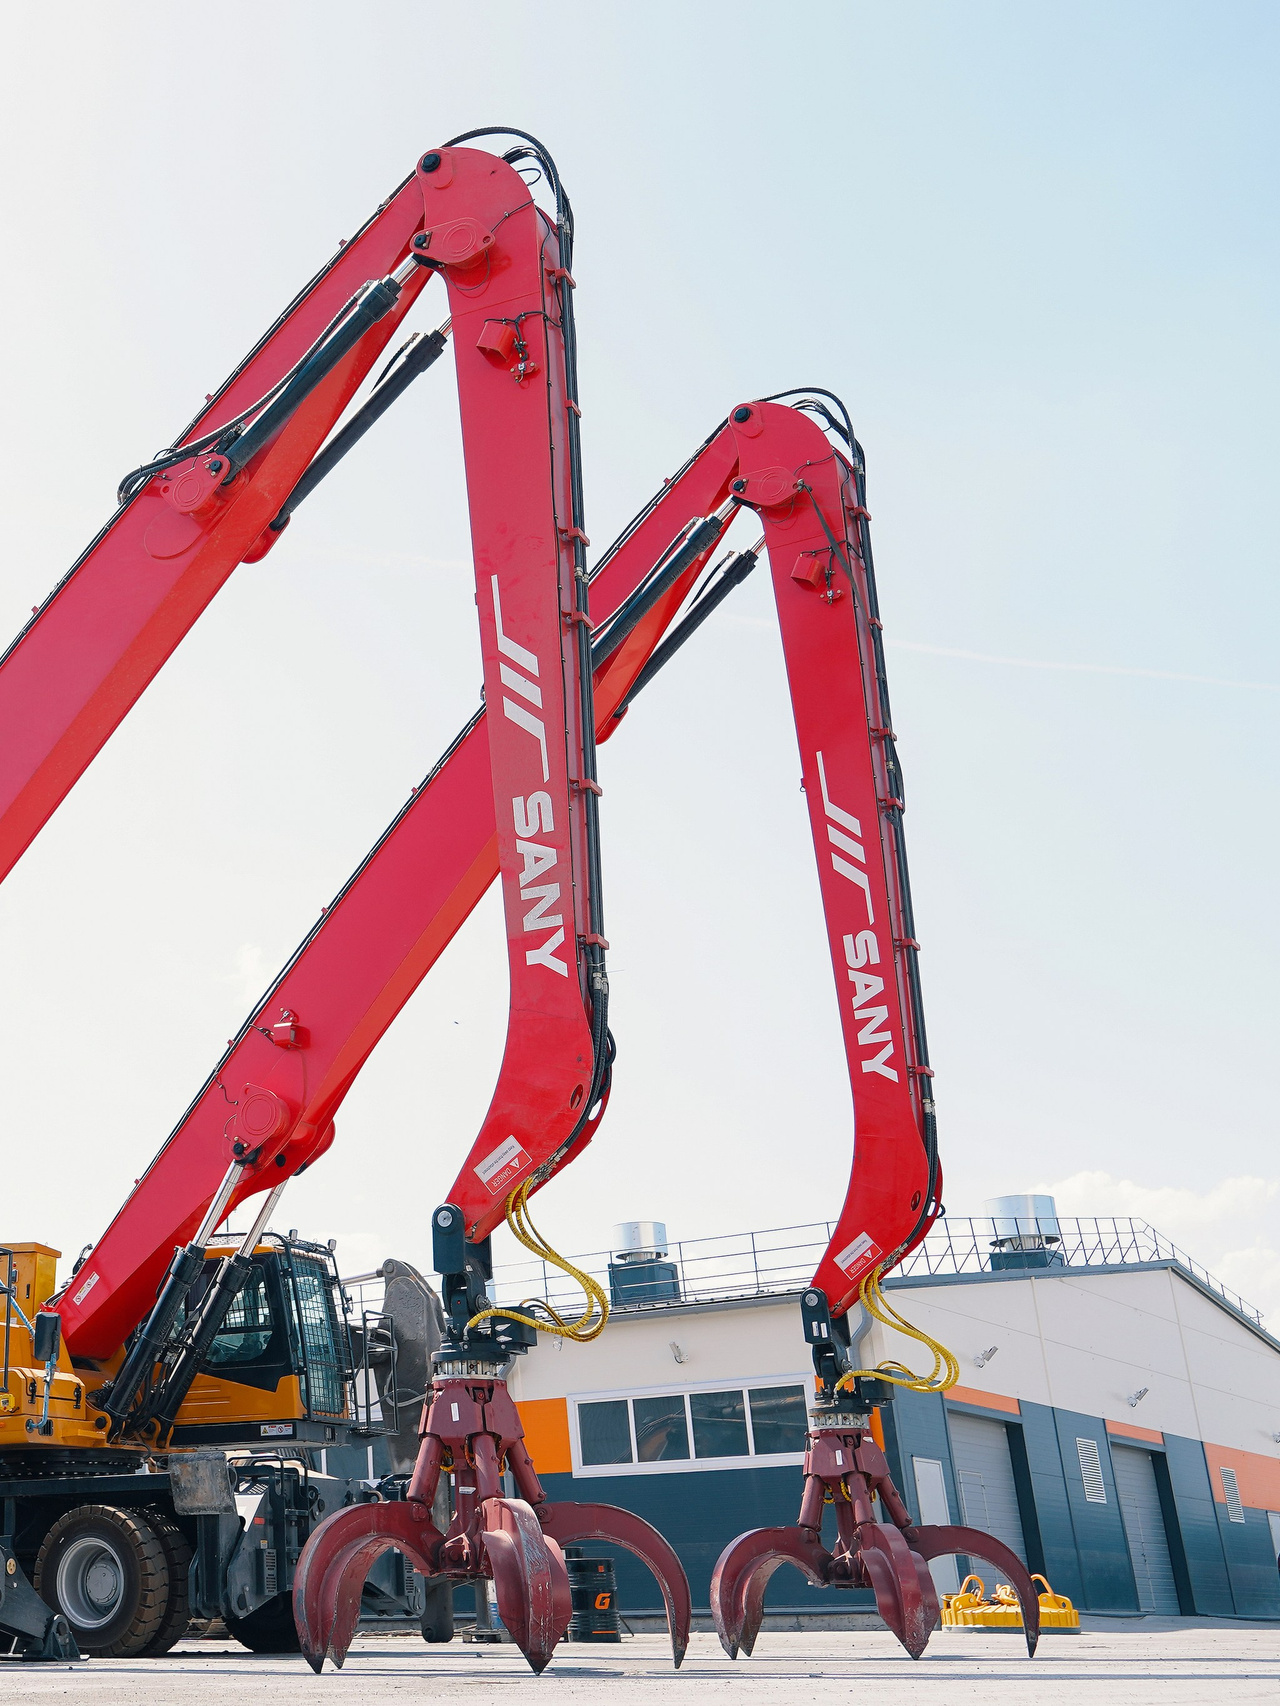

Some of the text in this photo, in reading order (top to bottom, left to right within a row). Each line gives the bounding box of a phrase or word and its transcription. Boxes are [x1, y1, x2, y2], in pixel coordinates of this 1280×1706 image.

[512, 791, 569, 978] SANY
[843, 930, 899, 1083] SANY
[491, 1167, 512, 1187] DANGER
[849, 1257, 866, 1274] DANGER
